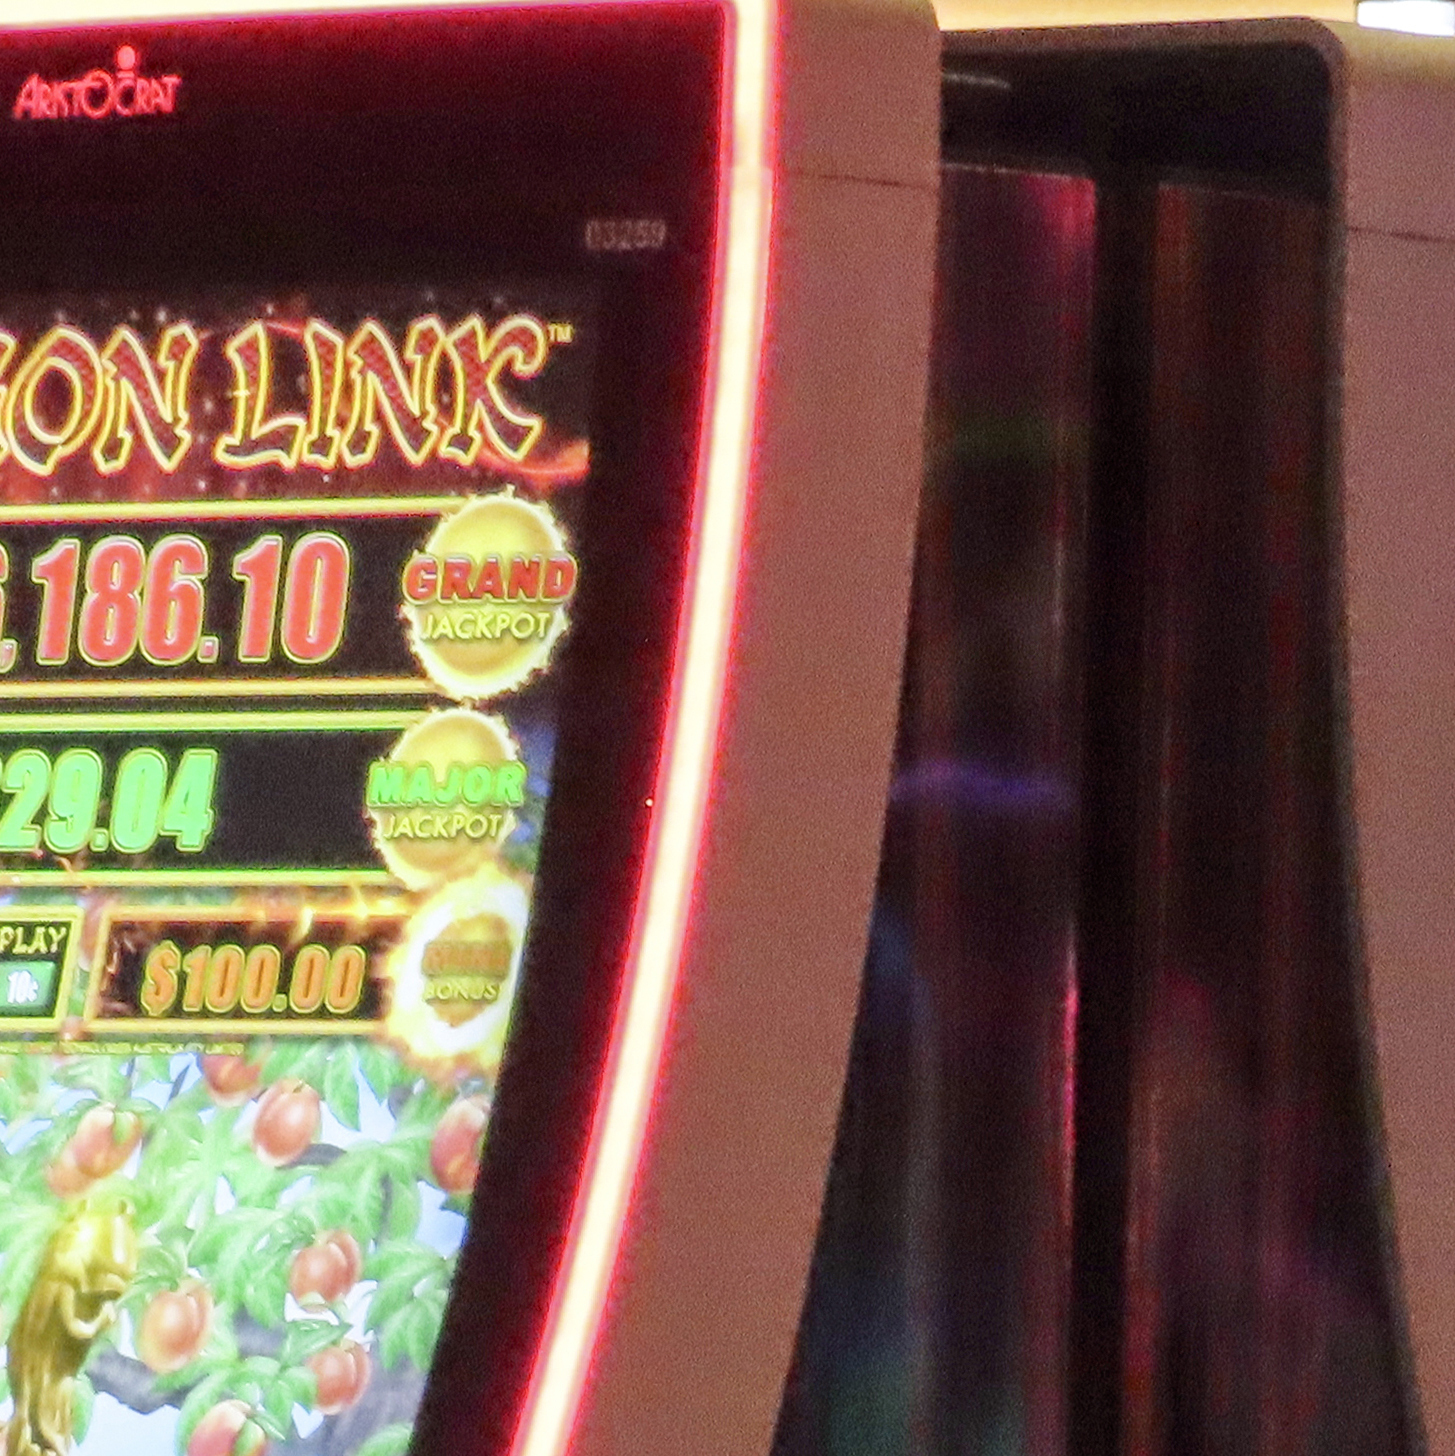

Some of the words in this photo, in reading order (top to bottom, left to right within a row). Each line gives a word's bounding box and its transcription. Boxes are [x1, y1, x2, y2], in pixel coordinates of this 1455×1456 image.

[211, 313, 550, 473] LINK
[401, 551, 579, 606] GRAND
[420, 610, 552, 641] JACKPOT
[367, 761, 529, 808] MAJOR
[382, 813, 506, 841] JACKPOT
[140, 940, 368, 1017] $100.00
